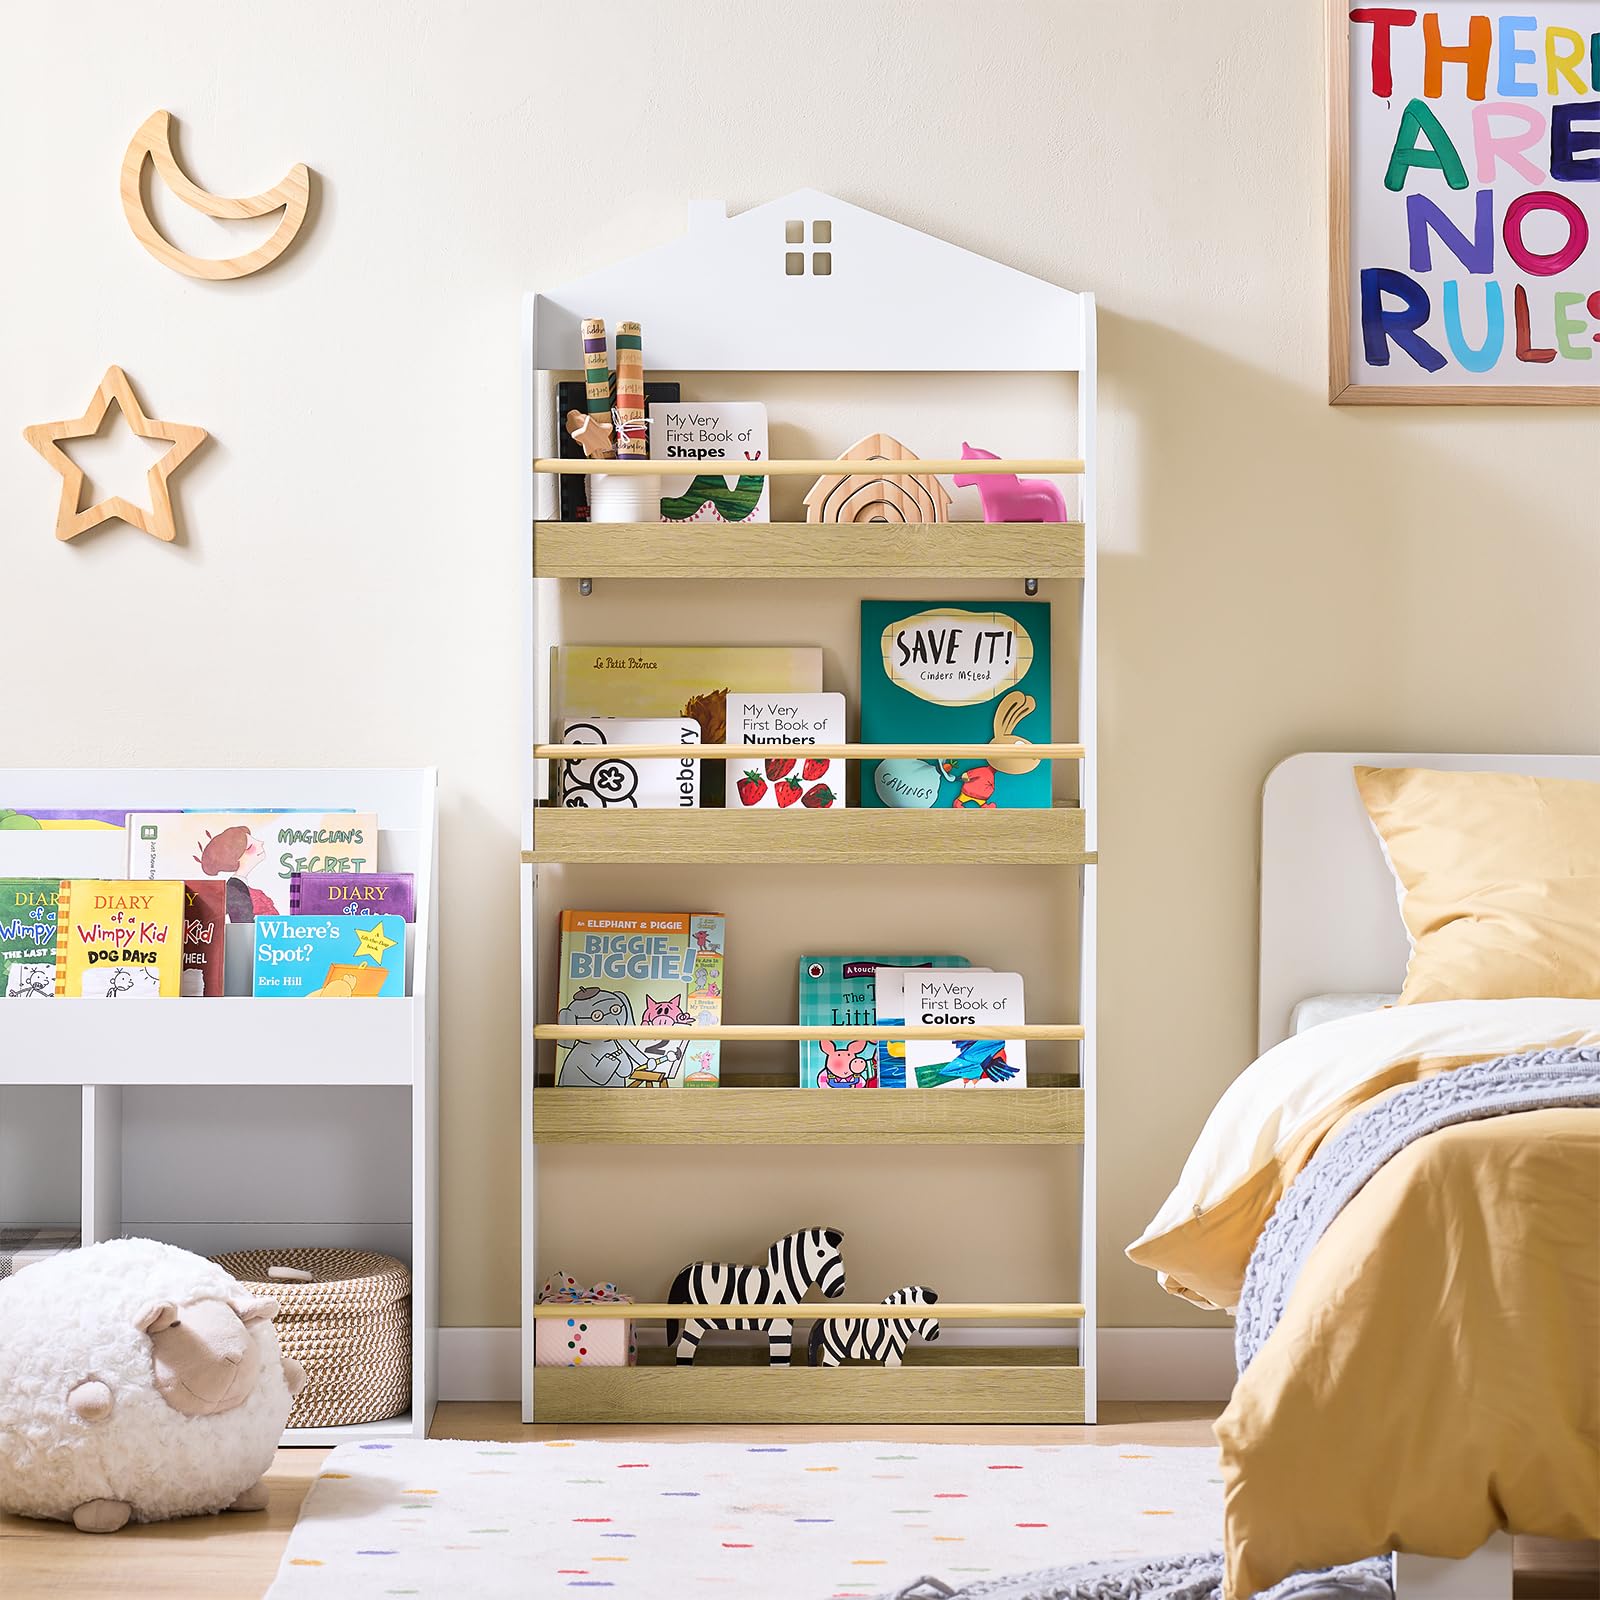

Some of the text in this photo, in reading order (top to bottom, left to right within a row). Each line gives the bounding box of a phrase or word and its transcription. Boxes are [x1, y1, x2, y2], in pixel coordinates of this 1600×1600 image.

[1349, 8, 1600, 101] THER
[1384, 98, 1600, 192] ARE
[1406, 189, 1589, 277] NO
[666, 414, 720, 429] My Very
[666, 429, 752, 442] First Book of
[667, 445, 725, 460] Shapes
[896, 629, 1013, 667] SAVE IT!
[593, 657, 658, 669] Le Petit Prince
[920, 671, 953, 681] Cinders
[743, 704, 798, 718] My Very
[743, 718, 828, 731] First Book of
[743, 734, 815, 745] Numbers
[881, 773, 933, 800] SAVINGS
[278, 828, 364, 845] MAGICIAN'S
[278, 852, 366, 879] SECRET
[328, 886, 389, 900] DIARY
[94, 895, 154, 909] DIARY
[343, 902, 370, 916] of a
[29, 906, 44, 920] of
[111, 912, 123, 924] of
[184, 919, 214, 944] Kid
[258, 921, 340, 939] Where's
[588, 919, 637, 929] ELEPHANT
[640, 921, 647, 929] &
[650, 921, 683, 930] PIGGIE
[0, 919, 57, 946] Wimpy
[77, 922, 168, 948] Wimpy Kid
[585, 934, 679, 955] BIGGIE-
[2, 951, 22, 960] THE
[24, 948, 48, 958] LAST
[88, 950, 157, 964] DOG DAYS
[258, 944, 313, 966] Spot?
[570, 948, 697, 983] BIGGIE!
[258, 976, 302, 986] Eric Hill
[921, 983, 974, 997] My Very
[843, 992, 865, 1004] The
[921, 998, 1007, 1009] First Book of
[921, 1013, 975, 1024] Colors
